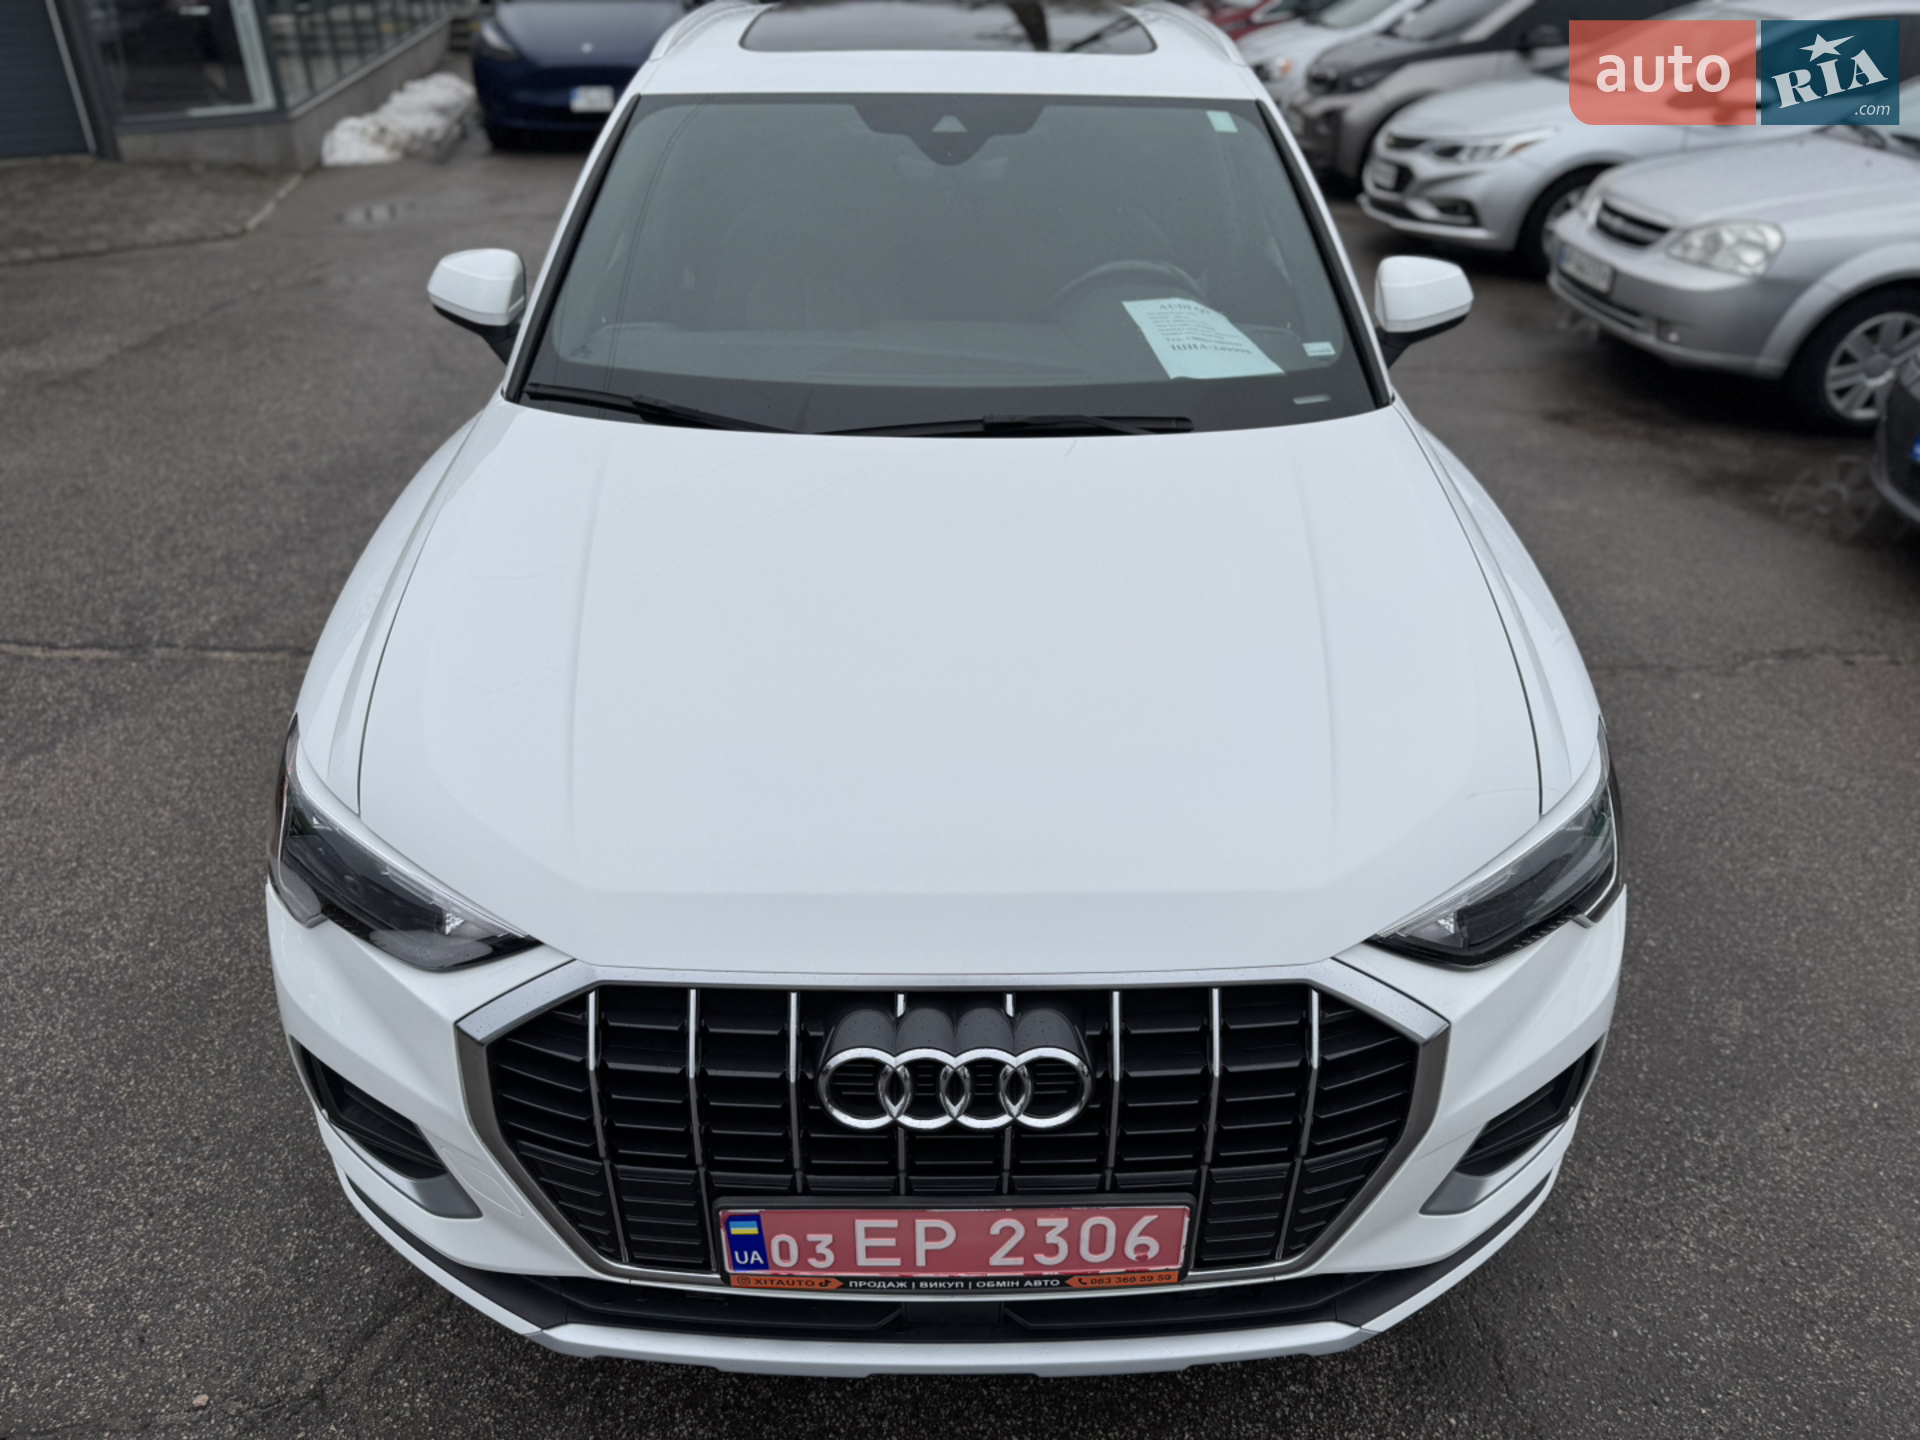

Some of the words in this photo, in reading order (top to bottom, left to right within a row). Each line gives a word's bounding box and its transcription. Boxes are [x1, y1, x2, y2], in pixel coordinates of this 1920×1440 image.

[771, 1233, 836, 1268] 03
[854, 1217, 957, 1267] EP
[988, 1214, 1161, 1267] 2306
[734, 1249, 764, 1266] UA
[754, 1278, 815, 1287] XITAUTO
[848, 1280, 908, 1289] ПРОДАЖ
[919, 1281, 964, 1289] ВИКУП
[976, 1280, 1020, 1288] ОБМІН
[1023, 1279, 1060, 1287] АВТО
